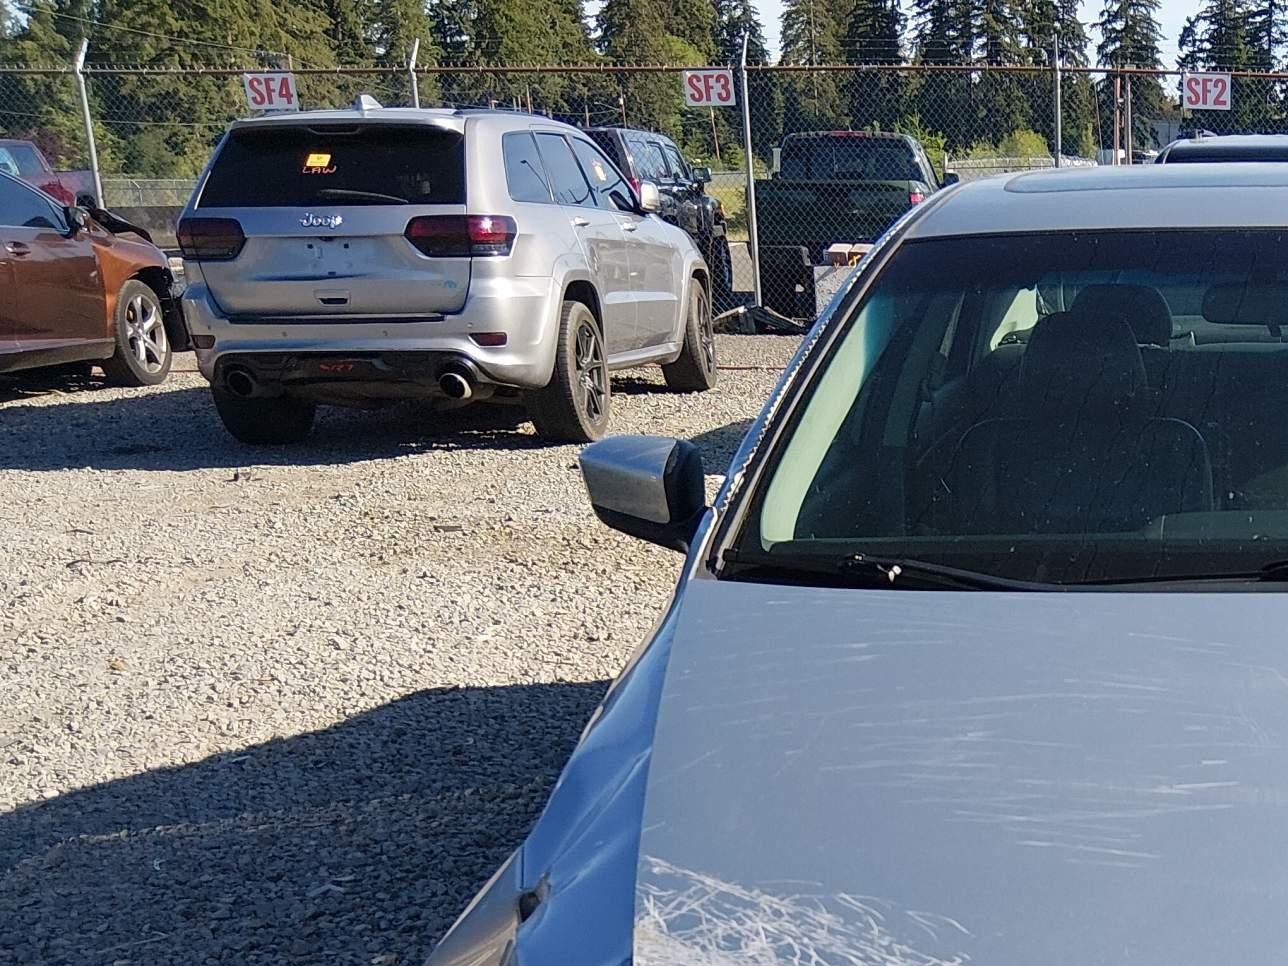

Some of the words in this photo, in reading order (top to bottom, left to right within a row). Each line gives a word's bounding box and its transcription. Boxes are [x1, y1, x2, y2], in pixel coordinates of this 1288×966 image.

[248, 77, 294, 106] SF4
[687, 73, 731, 103] SF3
[1186, 77, 1227, 106] SF2
